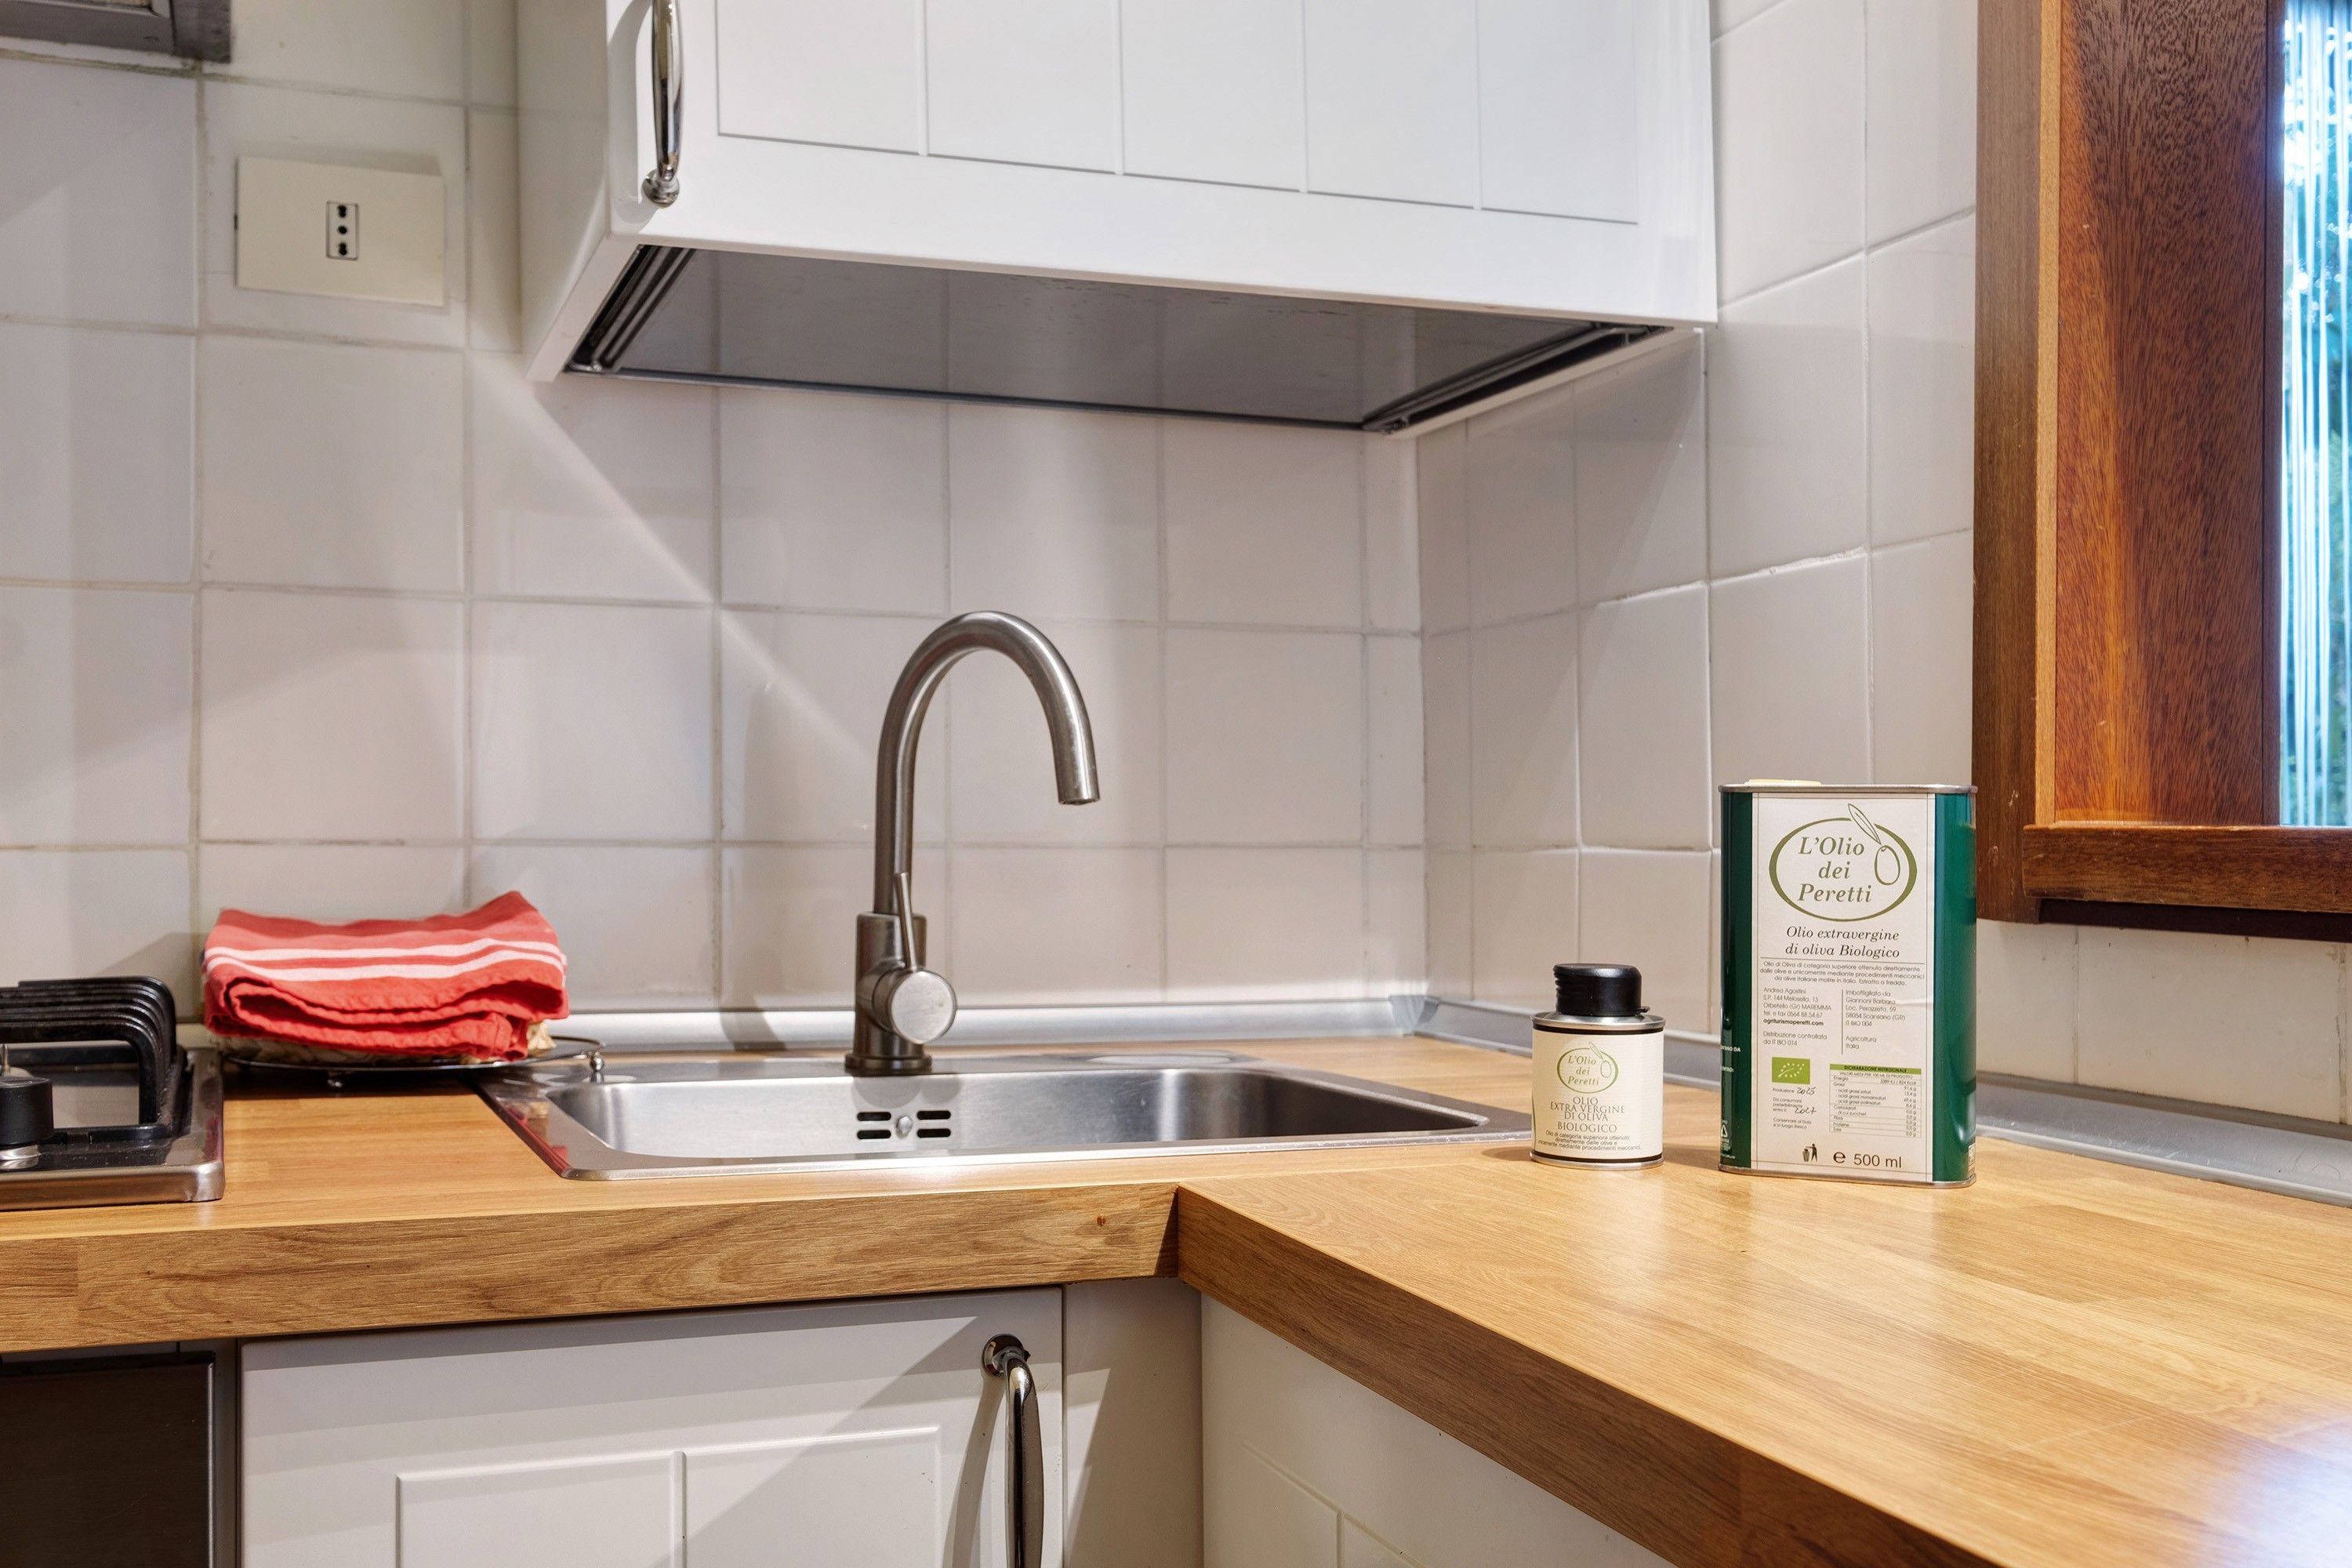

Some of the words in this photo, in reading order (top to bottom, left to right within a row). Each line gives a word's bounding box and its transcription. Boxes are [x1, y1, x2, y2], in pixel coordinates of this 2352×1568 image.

[1798, 837, 1865, 855] L'Olio
[1818, 861, 1850, 879] dei
[1797, 883, 1871, 902] Peretti
[1786, 926, 1813, 938] Olio
[1817, 928, 1900, 942] extravergine
[1785, 943, 1798, 954] di
[1802, 943, 1835, 956] oliva
[1839, 945, 1900, 960] Biologico
[1568, 1055, 1596, 1065] L'Olio
[1576, 1066, 1590, 1075] dei
[1568, 1076, 1599, 1085] Peretti
[1573, 1096, 1599, 1105] OLIO
[1551, 1102, 1577, 1112] EXTRA
[1580, 1105, 1624, 1113] VERGINE
[1577, 1112, 1609, 1121] OLIVA
[1557, 1121, 1617, 1133] BIOLOGICO
[1853, 1153, 1880, 1167] 500
[1886, 1156, 1902, 1168] ml
